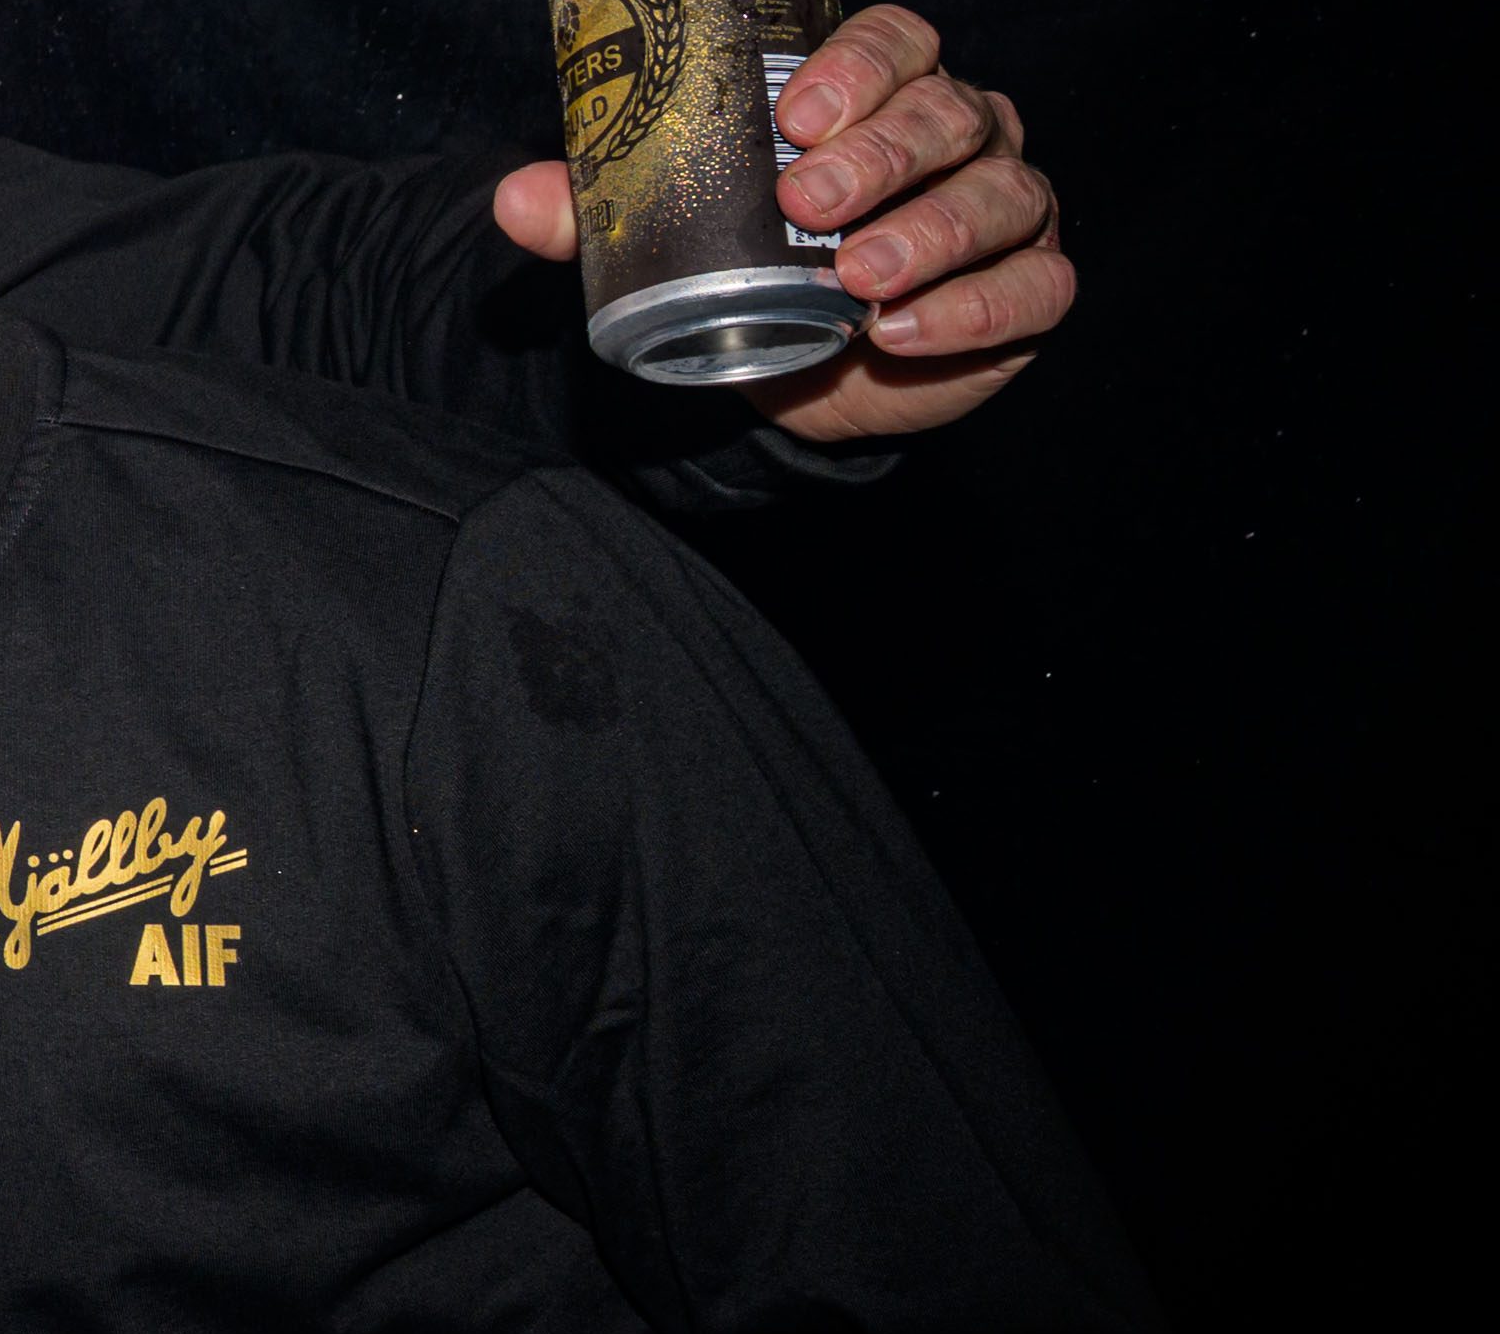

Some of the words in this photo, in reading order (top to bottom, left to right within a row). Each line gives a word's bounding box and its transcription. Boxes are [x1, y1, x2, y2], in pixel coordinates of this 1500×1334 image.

[563, 44, 623, 92] TERS
[568, 95, 609, 137] ULD
[129, 924, 242, 987] AIF
